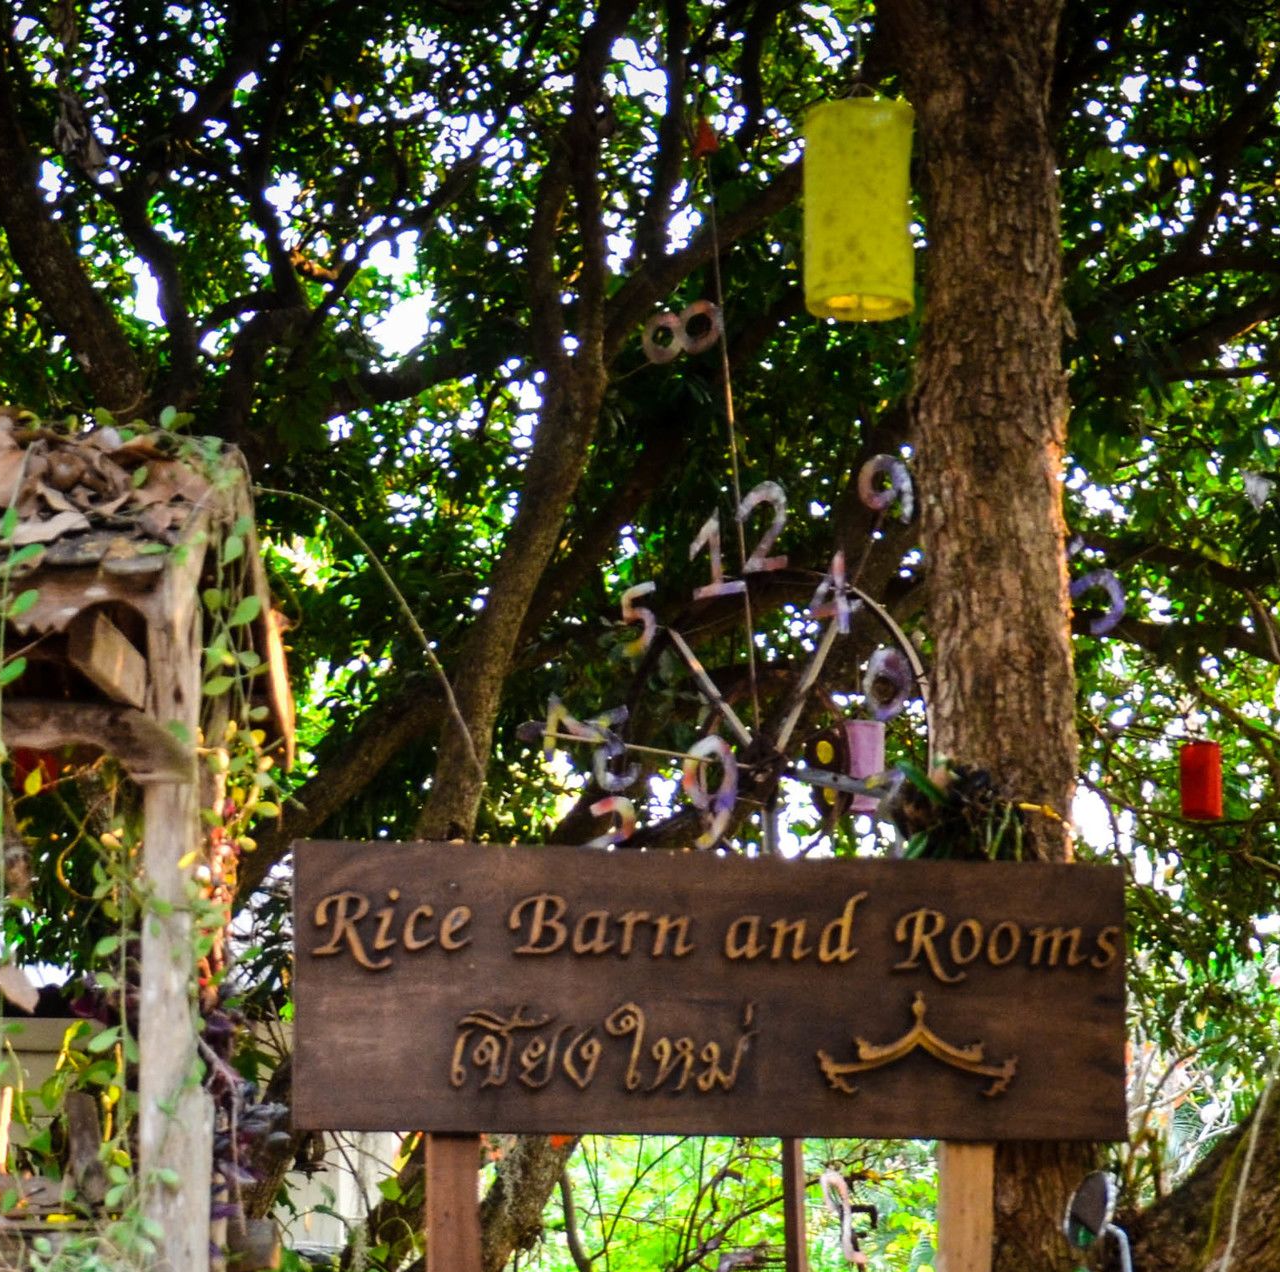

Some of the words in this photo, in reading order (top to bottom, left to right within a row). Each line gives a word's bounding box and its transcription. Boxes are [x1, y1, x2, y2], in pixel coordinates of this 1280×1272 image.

[311, 887, 472, 970] Rice
[509, 893, 696, 958] Barn
[724, 890, 868, 965] and
[892, 908, 1120, 985] Rooms
[449, 1000, 759, 1094] เชียงใหม่
